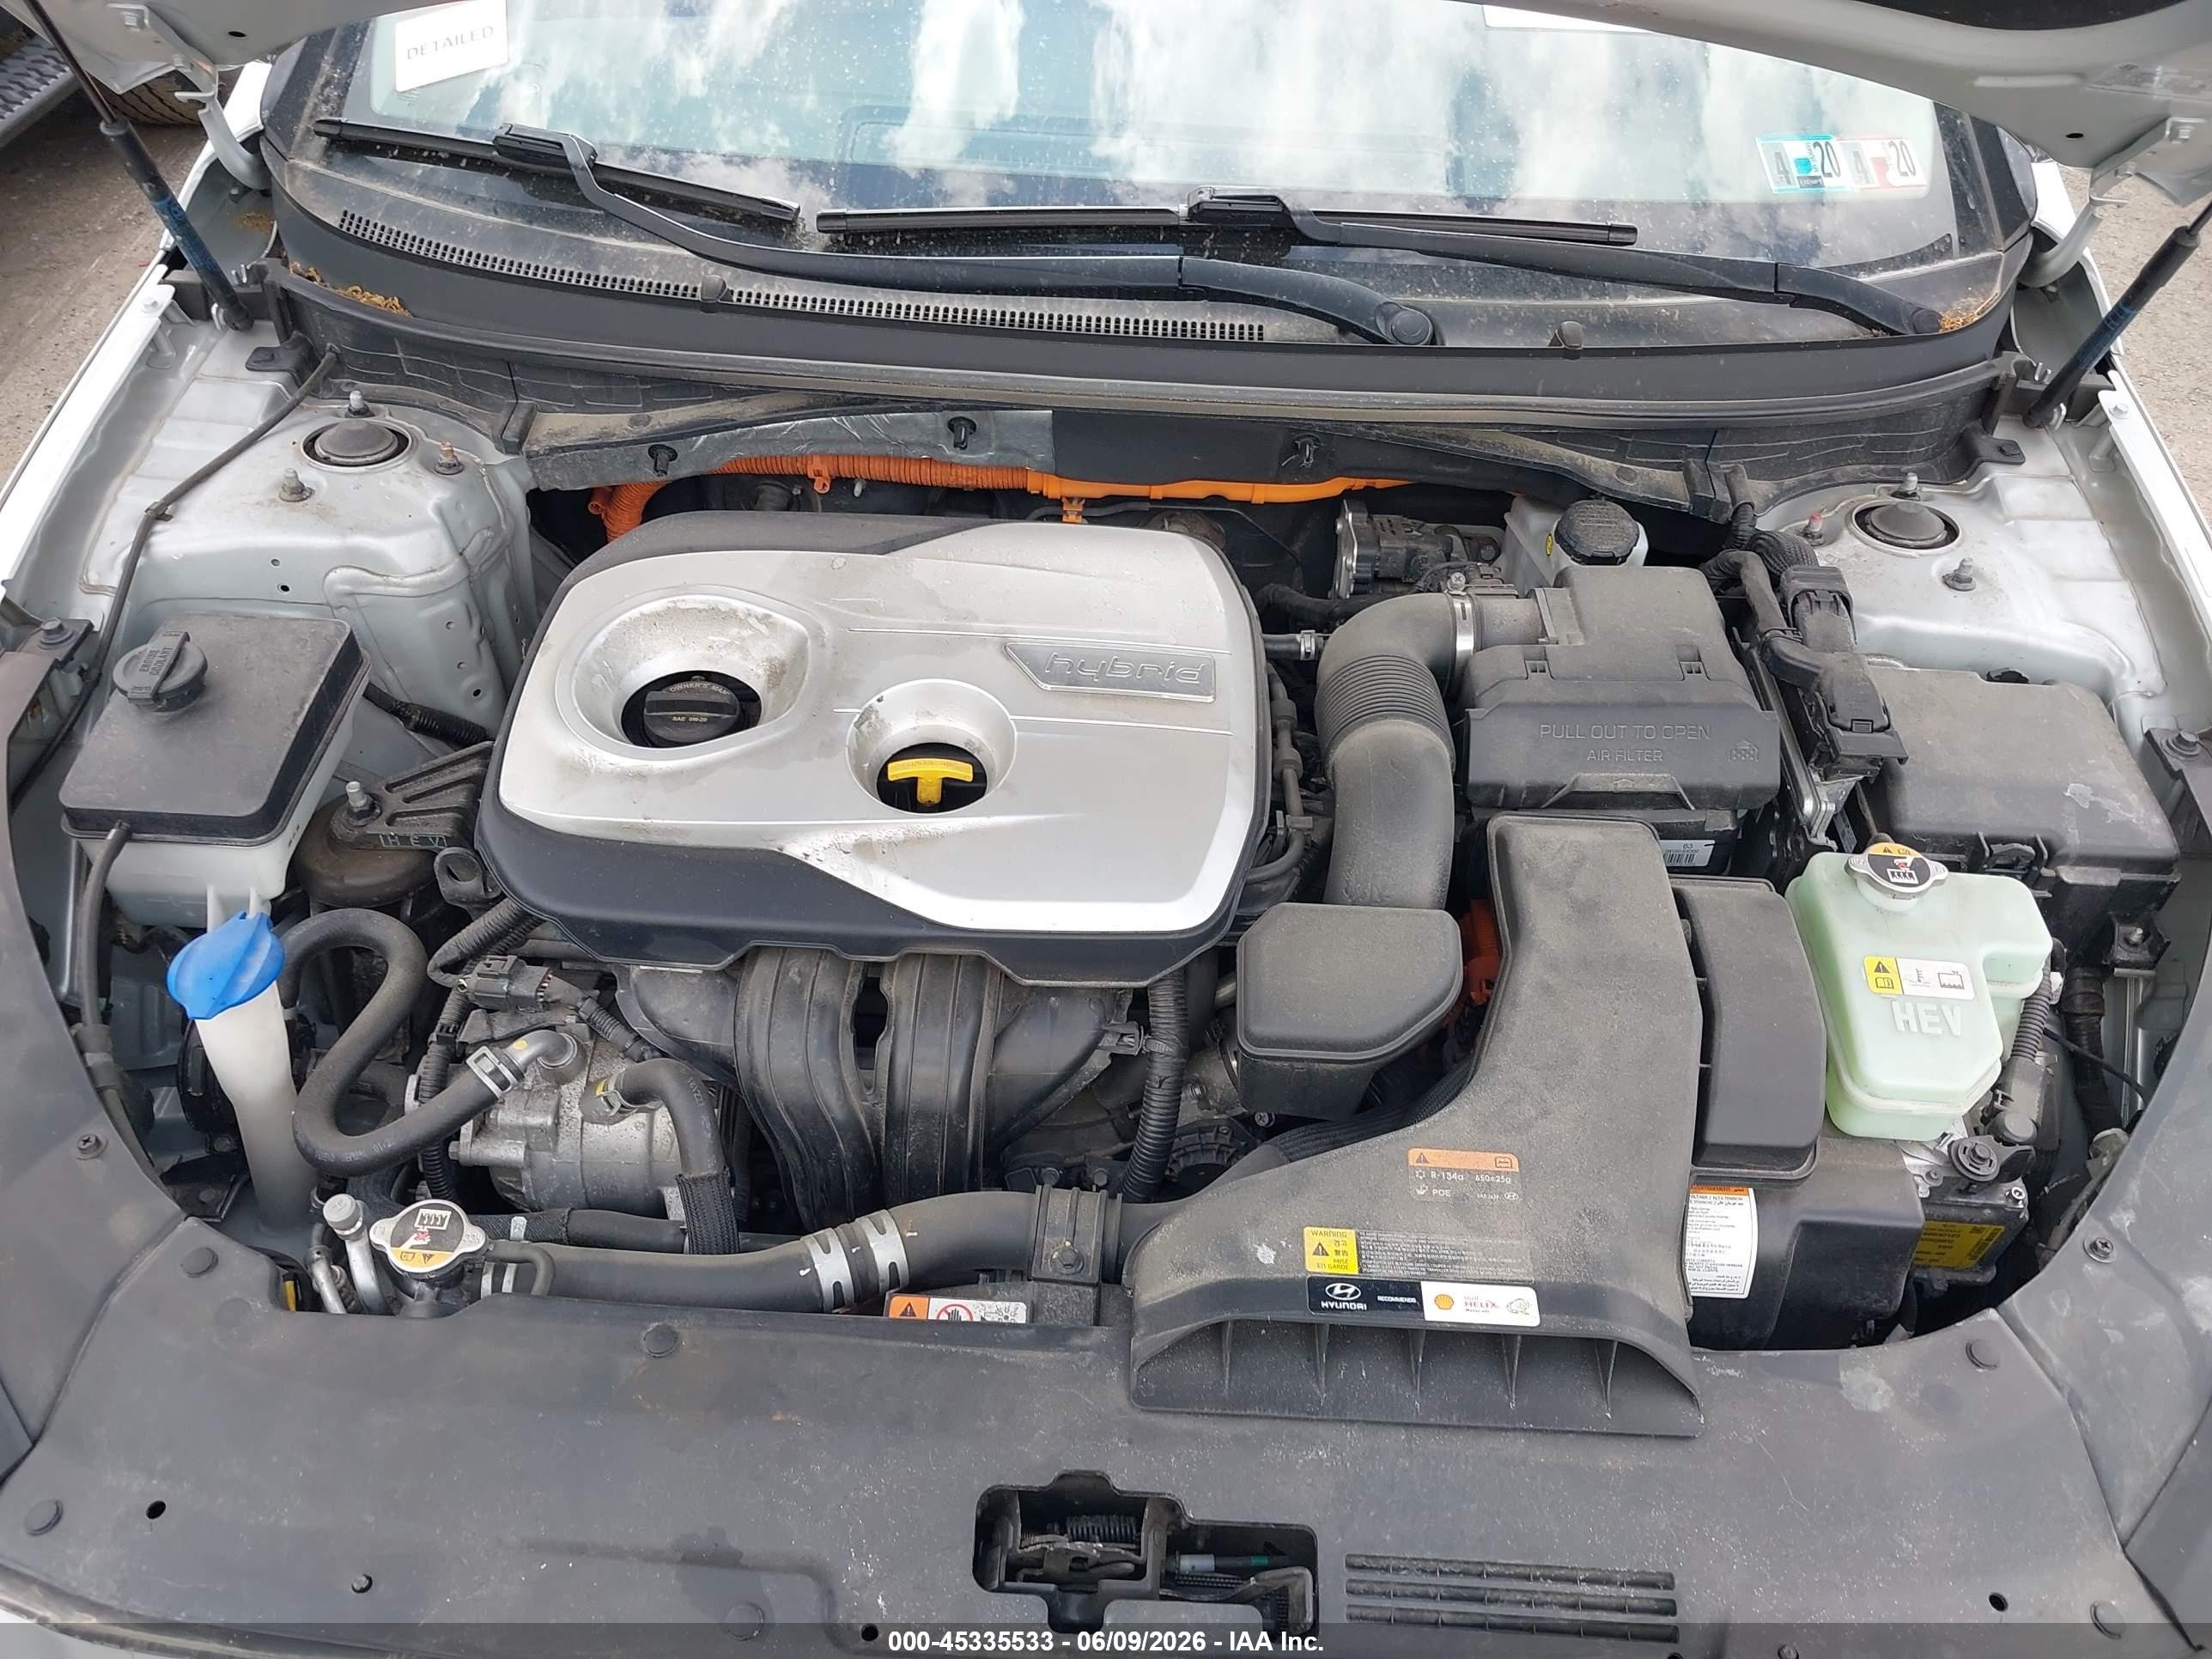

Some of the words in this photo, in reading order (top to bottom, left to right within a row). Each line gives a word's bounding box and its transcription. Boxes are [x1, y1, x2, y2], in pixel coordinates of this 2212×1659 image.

[407, 26, 495, 60] DETAILED
[1813, 140, 1842, 179] 20
[1888, 139, 1917, 178] 20
[1044, 652, 1206, 684] hybrid
[1540, 724, 1586, 739] PULL
[1590, 725, 1629, 739] OUT
[1632, 726, 1657, 739] TO
[1662, 726, 1711, 740] OPEN
[1587, 750, 1611, 762] AIR
[1615, 750, 1663, 763] FILTER
[1890, 1000, 1962, 1037] HEV
[1310, 1230, 1347, 1238] WARNING
[1321, 1300, 1367, 1310] HYUNDAI
